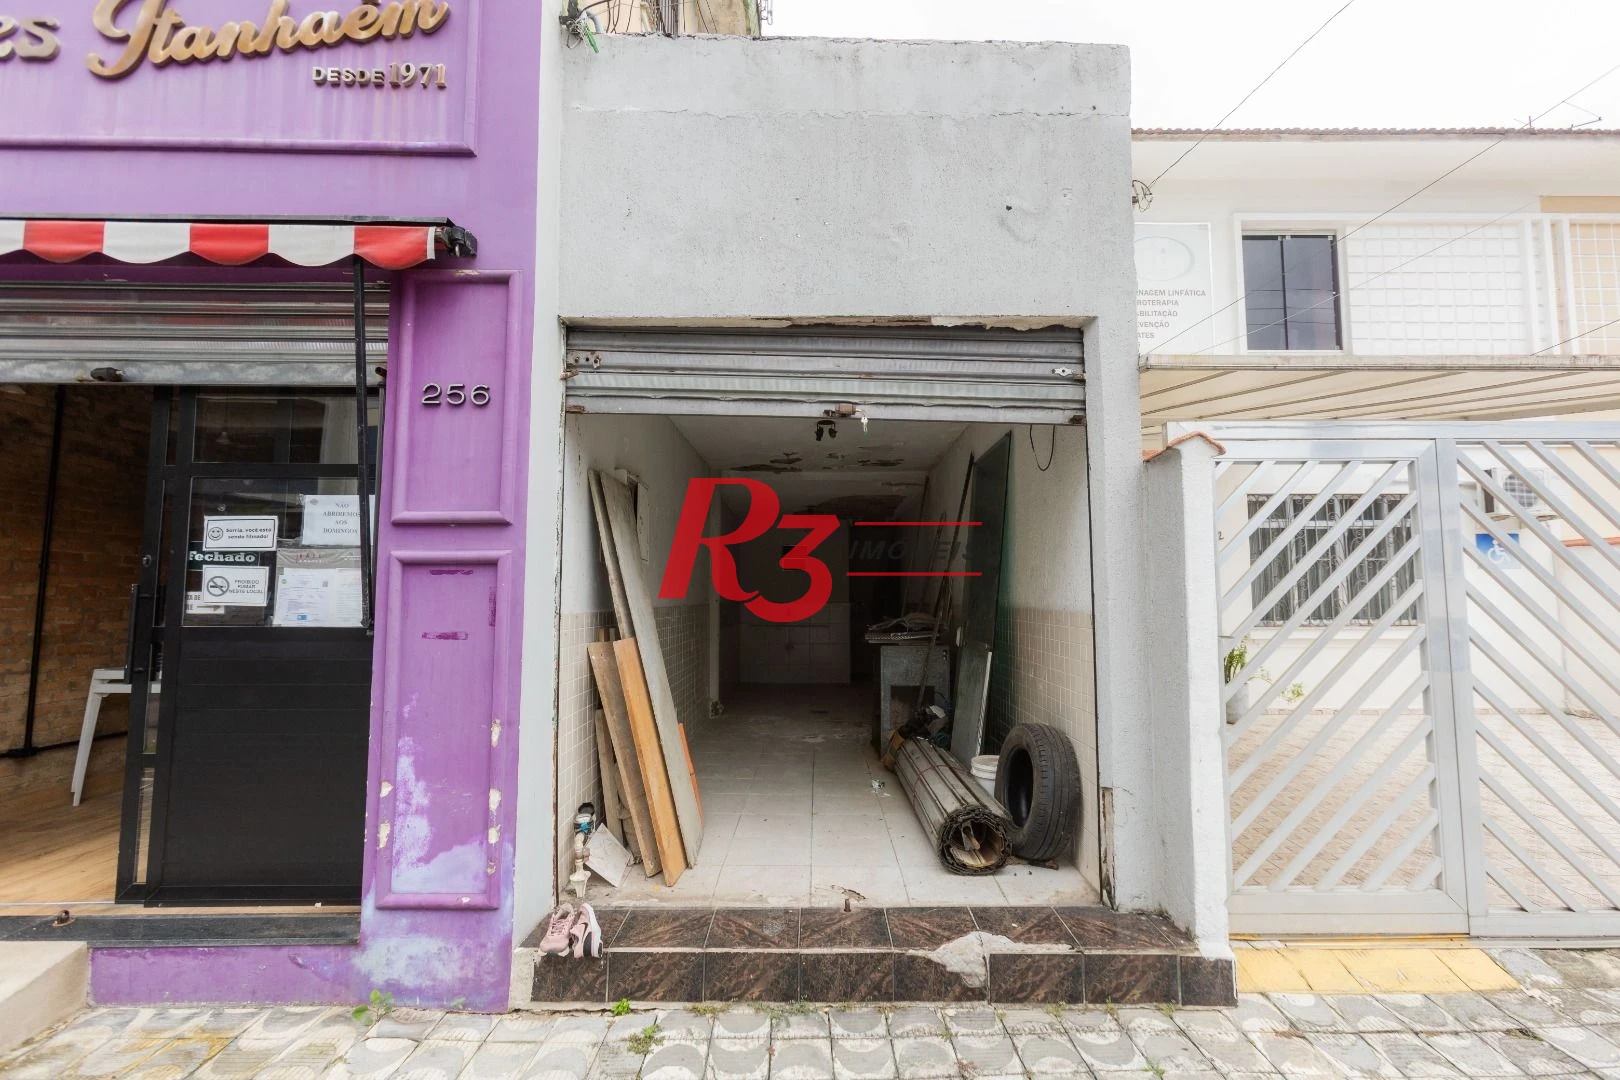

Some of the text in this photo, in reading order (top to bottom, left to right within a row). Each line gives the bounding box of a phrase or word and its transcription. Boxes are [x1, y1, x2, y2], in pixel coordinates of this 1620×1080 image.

[312, 63, 447, 89] DESDE 1971
[421, 382, 490, 406] 256
